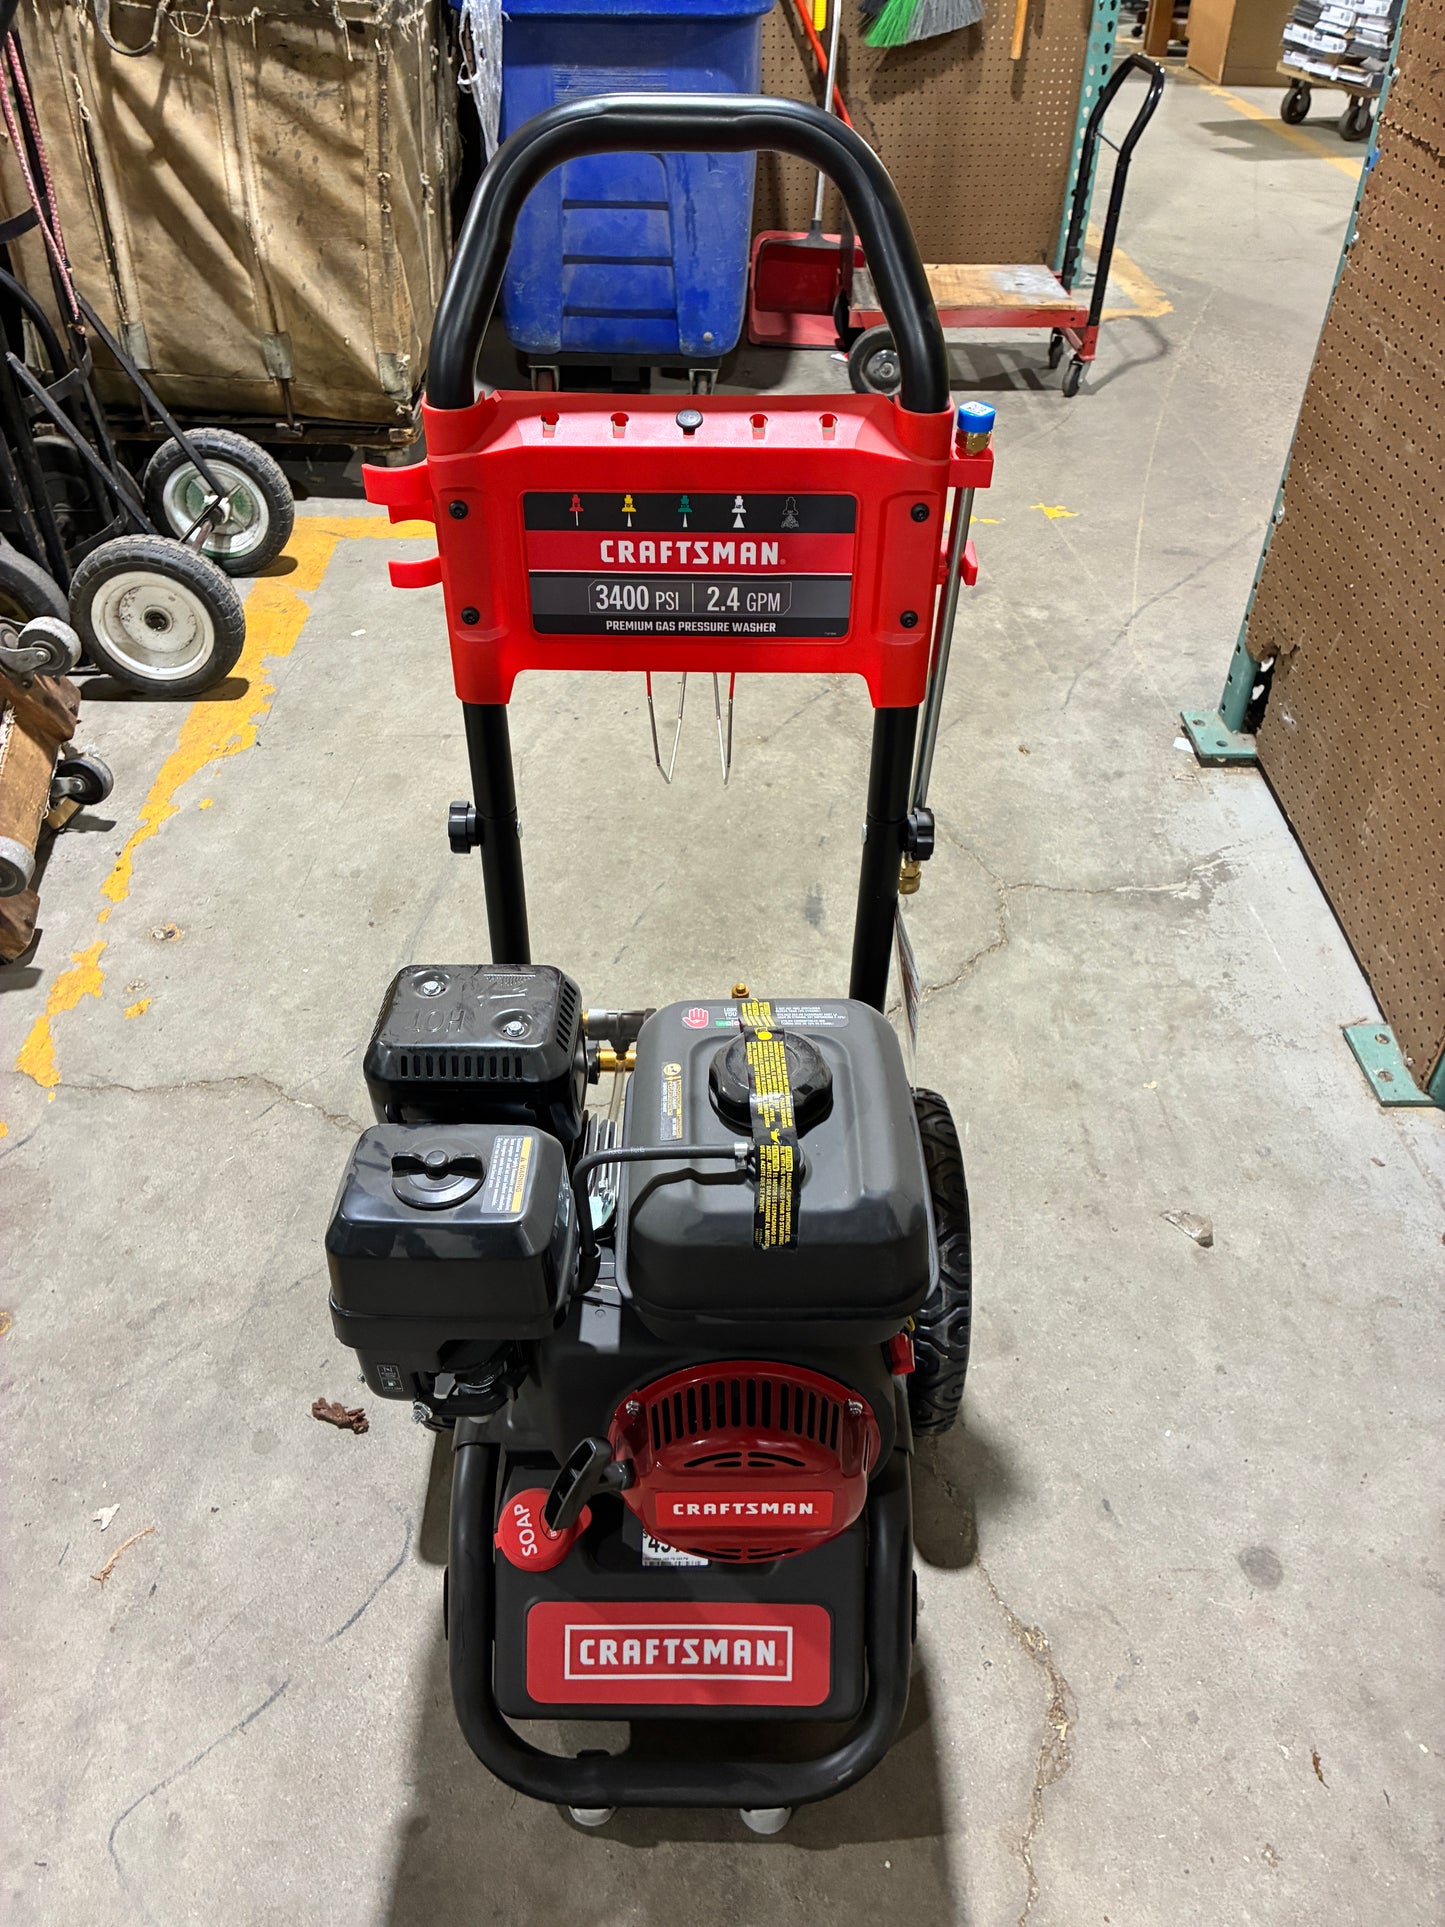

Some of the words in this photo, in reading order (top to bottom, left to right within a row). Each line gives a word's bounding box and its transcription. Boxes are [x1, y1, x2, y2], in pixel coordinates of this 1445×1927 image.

[600, 540, 778, 565] CRAFTSMAN
[595, 584, 649, 610] 3400
[656, 592, 679, 611] PSI
[707, 586, 740, 612] 2.4
[747, 592, 780, 612] GPM
[606, 620, 653, 631] PREMIUM
[656, 621, 675, 632] GAS
[678, 621, 730, 632] PRESSURE
[732, 622, 776, 633] WASHER
[516, 1165, 526, 1193] WARNING
[673, 1503, 814, 1515] CRAFTSMAN
[513, 1504, 538, 1557] SOAP
[579, 1638, 776, 1666] CRAFTSMAN
